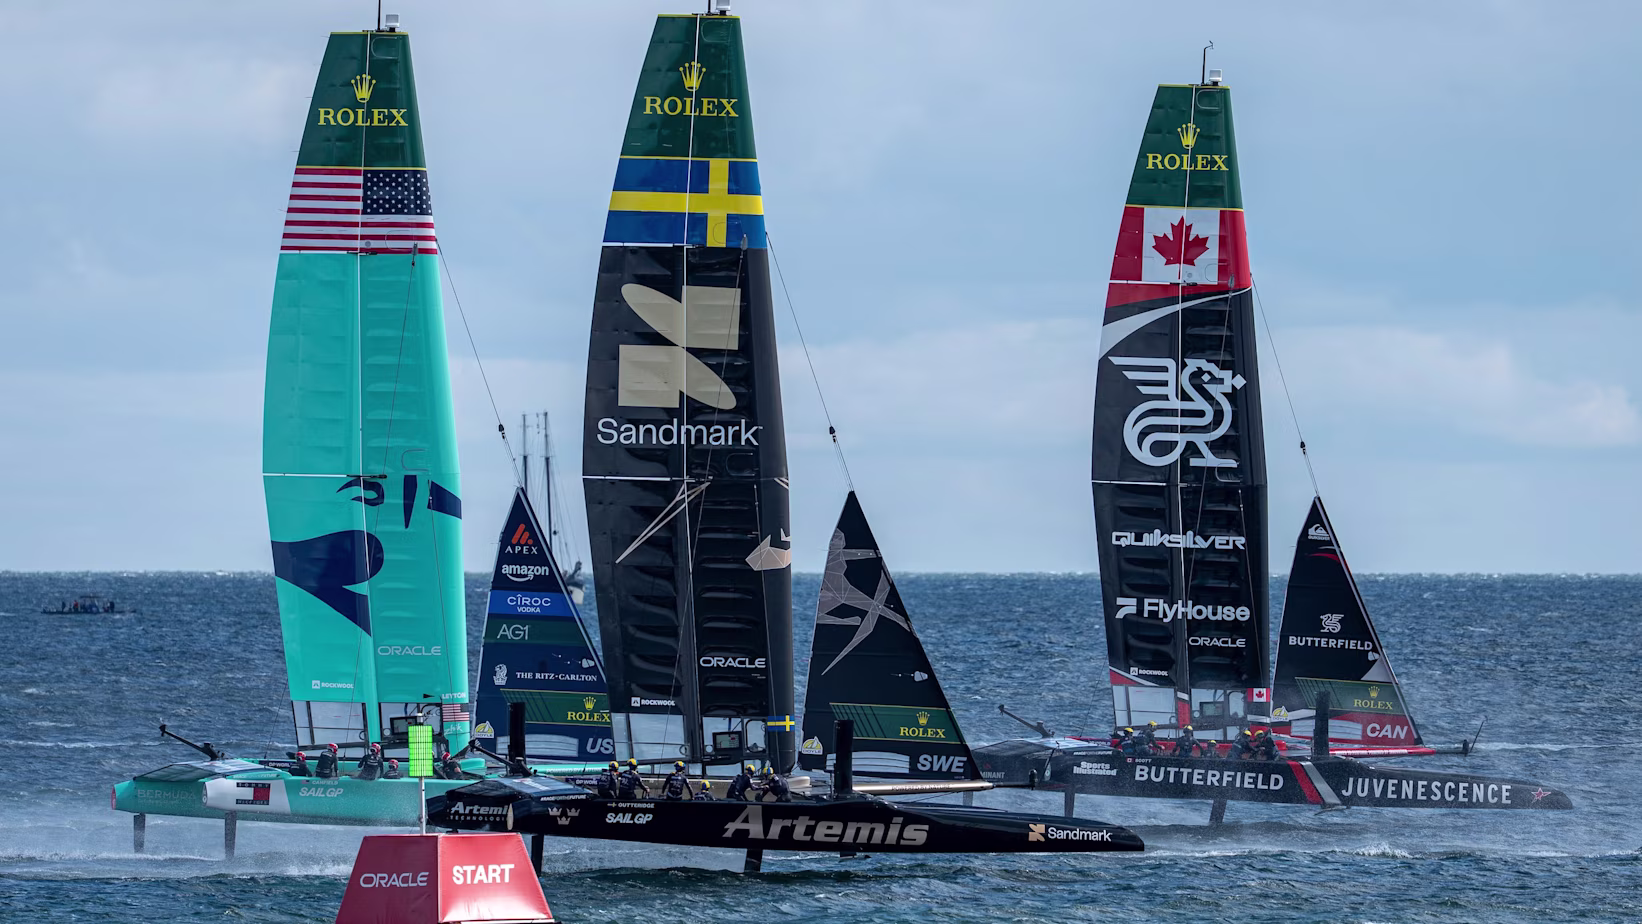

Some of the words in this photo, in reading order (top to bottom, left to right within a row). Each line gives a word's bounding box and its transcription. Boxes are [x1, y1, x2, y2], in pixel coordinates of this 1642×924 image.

[643, 96, 739, 118] ROLEX
[317, 108, 408, 127] ROLEX
[1146, 153, 1229, 171] ROLEX
[596, 418, 760, 446] Sandmark
[504, 545, 538, 555] APEX
[501, 564, 549, 576] amazon
[1143, 598, 1250, 623] FlyHouse
[496, 623, 529, 641] AG1
[1188, 636, 1246, 648] ORACLE
[1288, 635, 1373, 651] BUTTERFIELD
[377, 646, 442, 656] ORACLE
[699, 656, 766, 668] ORACLE
[515, 671, 533, 679] THE
[1138, 668, 1168, 677] ROCKWOOL
[321, 681, 354, 690] ROCKWOOL
[441, 691, 466, 699] LEYTON
[641, 698, 676, 707] ROCKWOOL
[1353, 699, 1393, 711] ROLEX
[567, 711, 611, 723] ROLEX
[899, 727, 946, 739] ROLEX
[1366, 722, 1408, 740] CAN
[586, 737, 615, 754] US
[917, 754, 967, 773] SWE
[1080, 761, 1110, 770] Sports
[1073, 766, 1117, 776] Illustrated
[1134, 765, 1284, 791] BUTTERFIELD
[137, 788, 196, 800] BERMUDA
[1341, 777, 1512, 804] JUVENESCENCE
[451, 801, 508, 815] Artemi
[722, 805, 929, 846] Artemis
[1048, 827, 1112, 842] Sandmark
[359, 871, 429, 888] ORACLE
[452, 863, 515, 885] START
